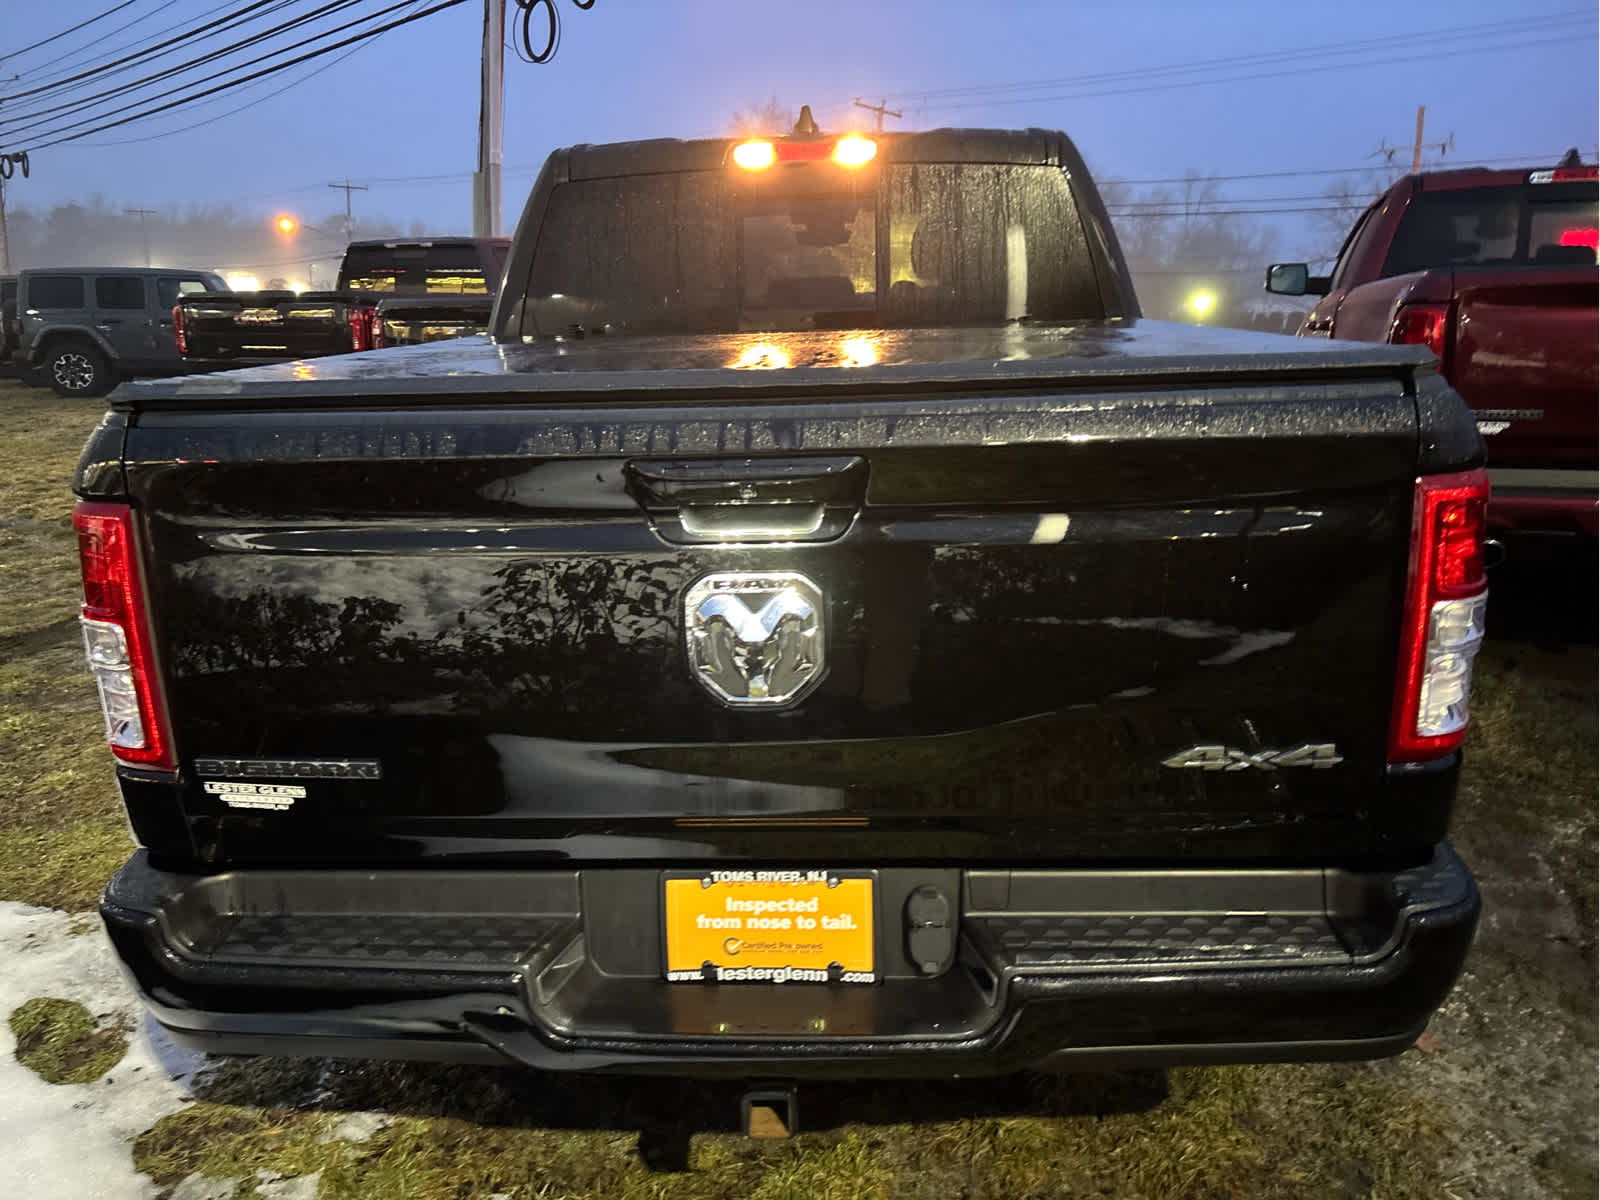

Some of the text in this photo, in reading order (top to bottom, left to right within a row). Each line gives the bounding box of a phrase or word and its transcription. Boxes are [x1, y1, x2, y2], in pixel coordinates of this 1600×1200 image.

[1160, 744, 1344, 771] 4x4
[204, 783, 256, 793] LESTER
[710, 871, 754, 882] TOMS
[725, 897, 819, 915] Inspected
[696, 913, 858, 930] from nose to tail.
[667, 966, 875, 983] www. lesterglenn .com
